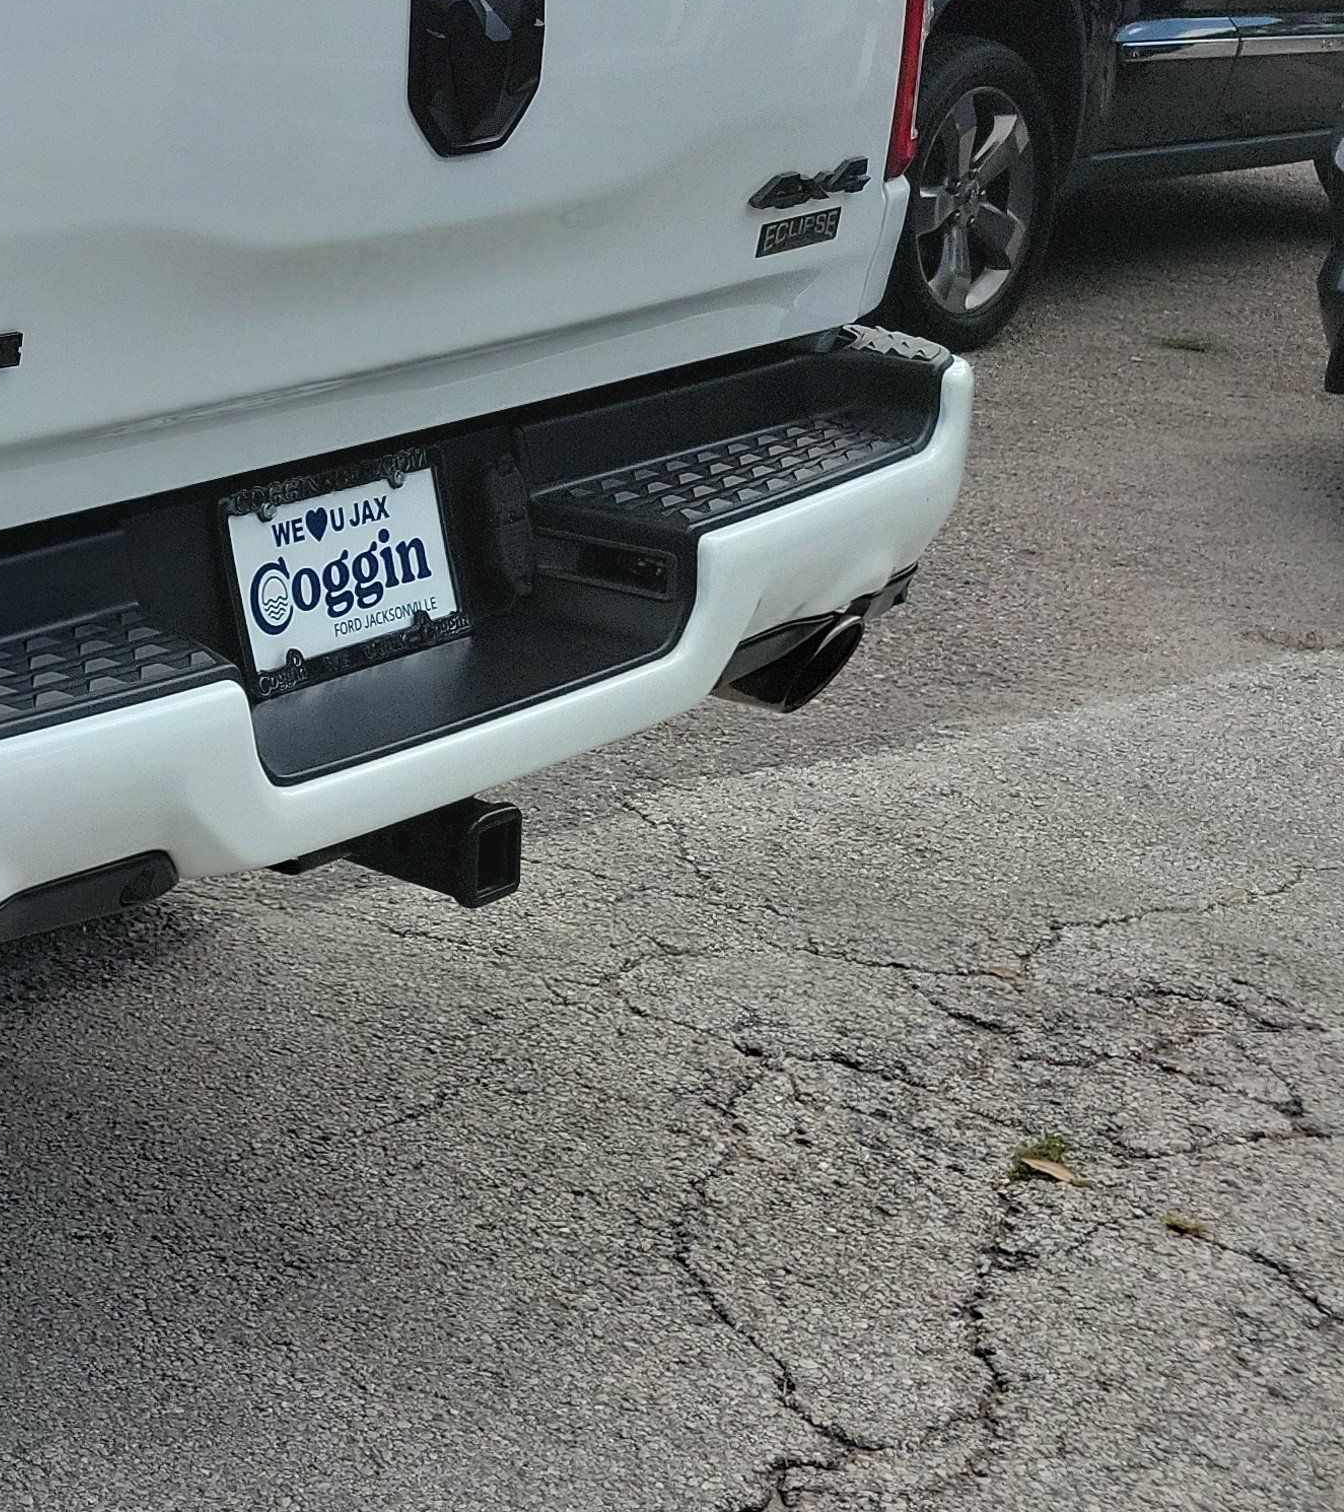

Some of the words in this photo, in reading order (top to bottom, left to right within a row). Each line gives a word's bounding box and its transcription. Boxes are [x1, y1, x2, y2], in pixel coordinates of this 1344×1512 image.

[763, 210, 839, 251] ECLIPSE
[271, 519, 306, 548] WE
[330, 507, 345, 531] U
[349, 495, 390, 527] JAX
[250, 528, 432, 635] Coggin
[334, 617, 362, 637] FORD
